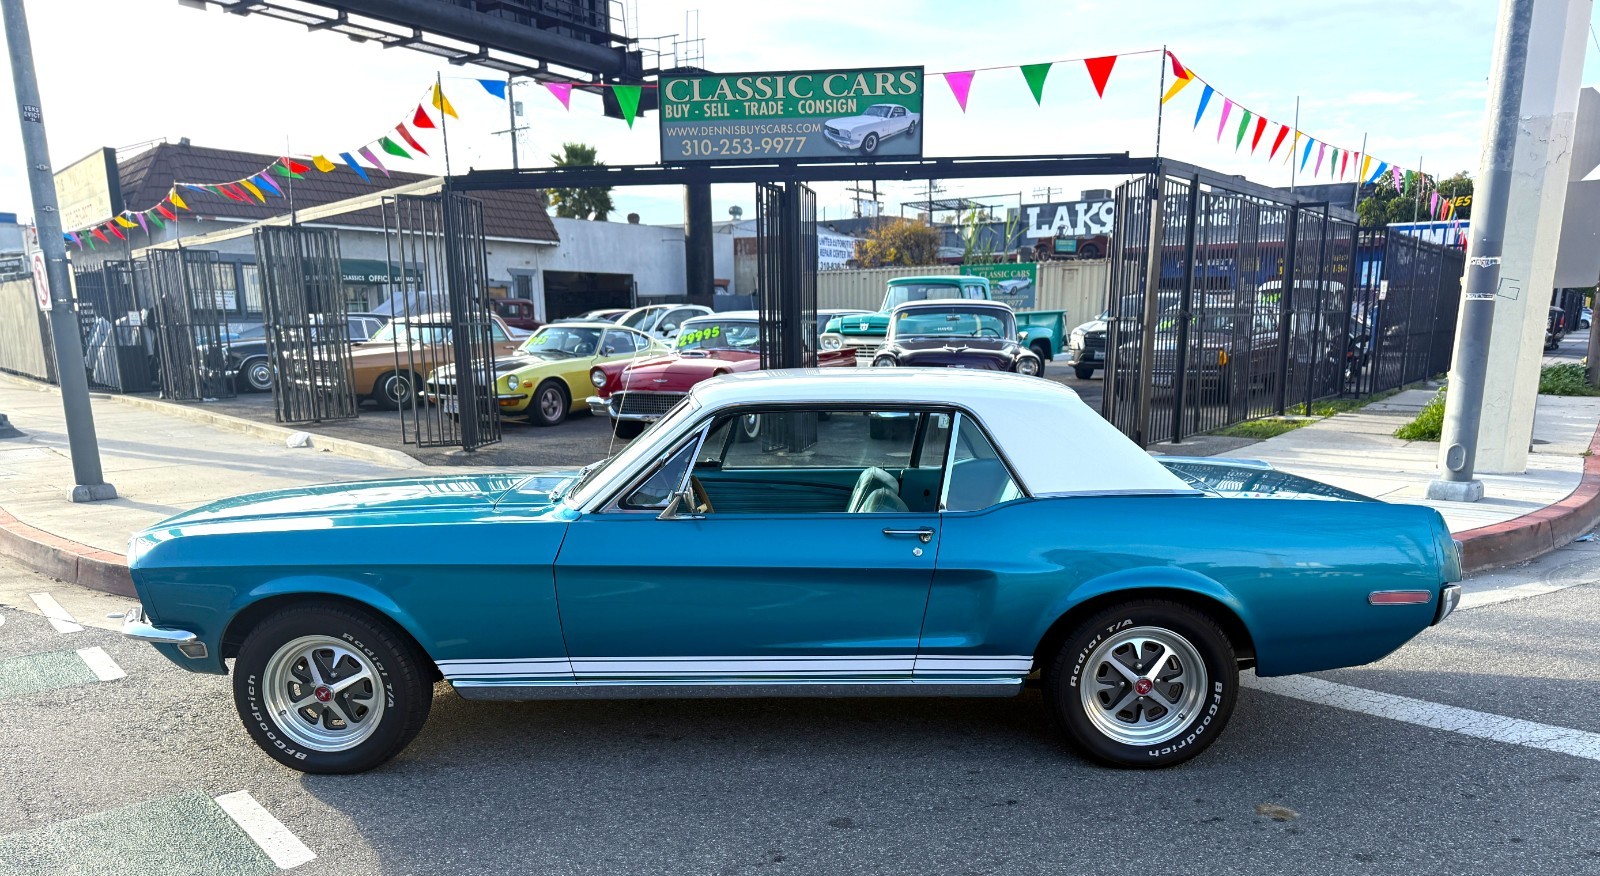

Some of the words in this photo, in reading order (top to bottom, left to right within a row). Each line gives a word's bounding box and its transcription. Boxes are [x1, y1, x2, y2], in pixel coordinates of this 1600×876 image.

[665, 74, 814, 103] CLASSIC
[822, 71, 918, 98] CARS
[665, 104, 690, 119] BUY
[704, 102, 730, 117] SELL
[743, 101, 784, 116] TRADE
[798, 98, 857, 114] CONSIGN
[666, 123, 822, 137] WWW.DENNISBUYSCARS.COM
[681, 136, 807, 157] 310-253-9977
[368, 274, 389, 282] OFFIC
[979, 271, 1010, 279] CLASSIC
[1011, 269, 1031, 278] CARS
[679, 325, 720, 347] 29995
[1069, 633, 1102, 688] Radial
[1106, 618, 1134, 633] T/A
[341, 632, 388, 677] Radial
[385, 682, 395, 709] T/A
[247, 674, 308, 761] BFGoodrich
[1148, 681, 1223, 758] BFGoodrich
